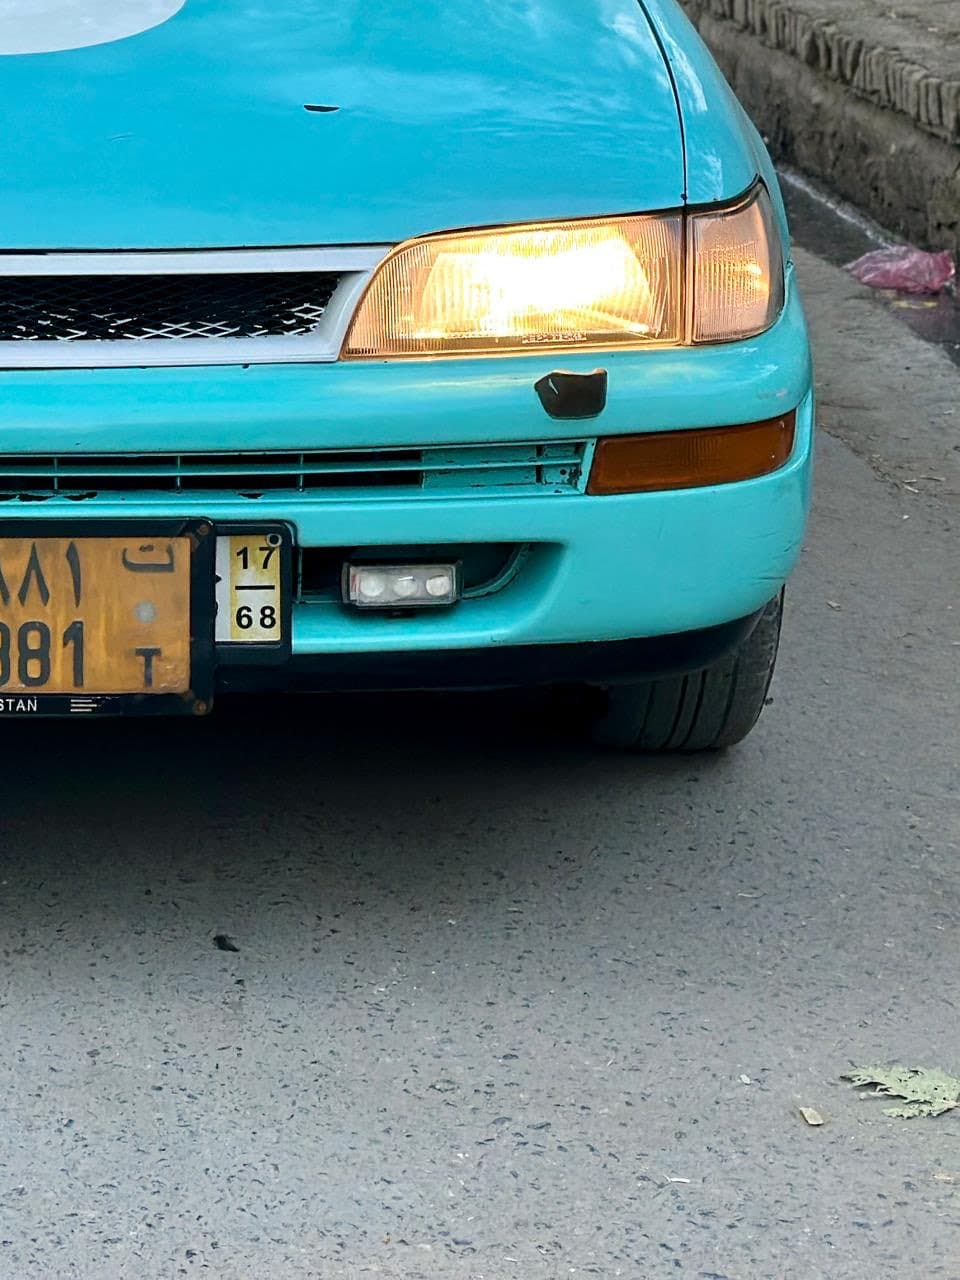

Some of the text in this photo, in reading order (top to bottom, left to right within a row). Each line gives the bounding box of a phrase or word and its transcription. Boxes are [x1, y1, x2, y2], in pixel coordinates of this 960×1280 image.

[236, 546, 276, 570] 17
[235, 605, 277, 630] 68
[135, 647, 161, 688] T
